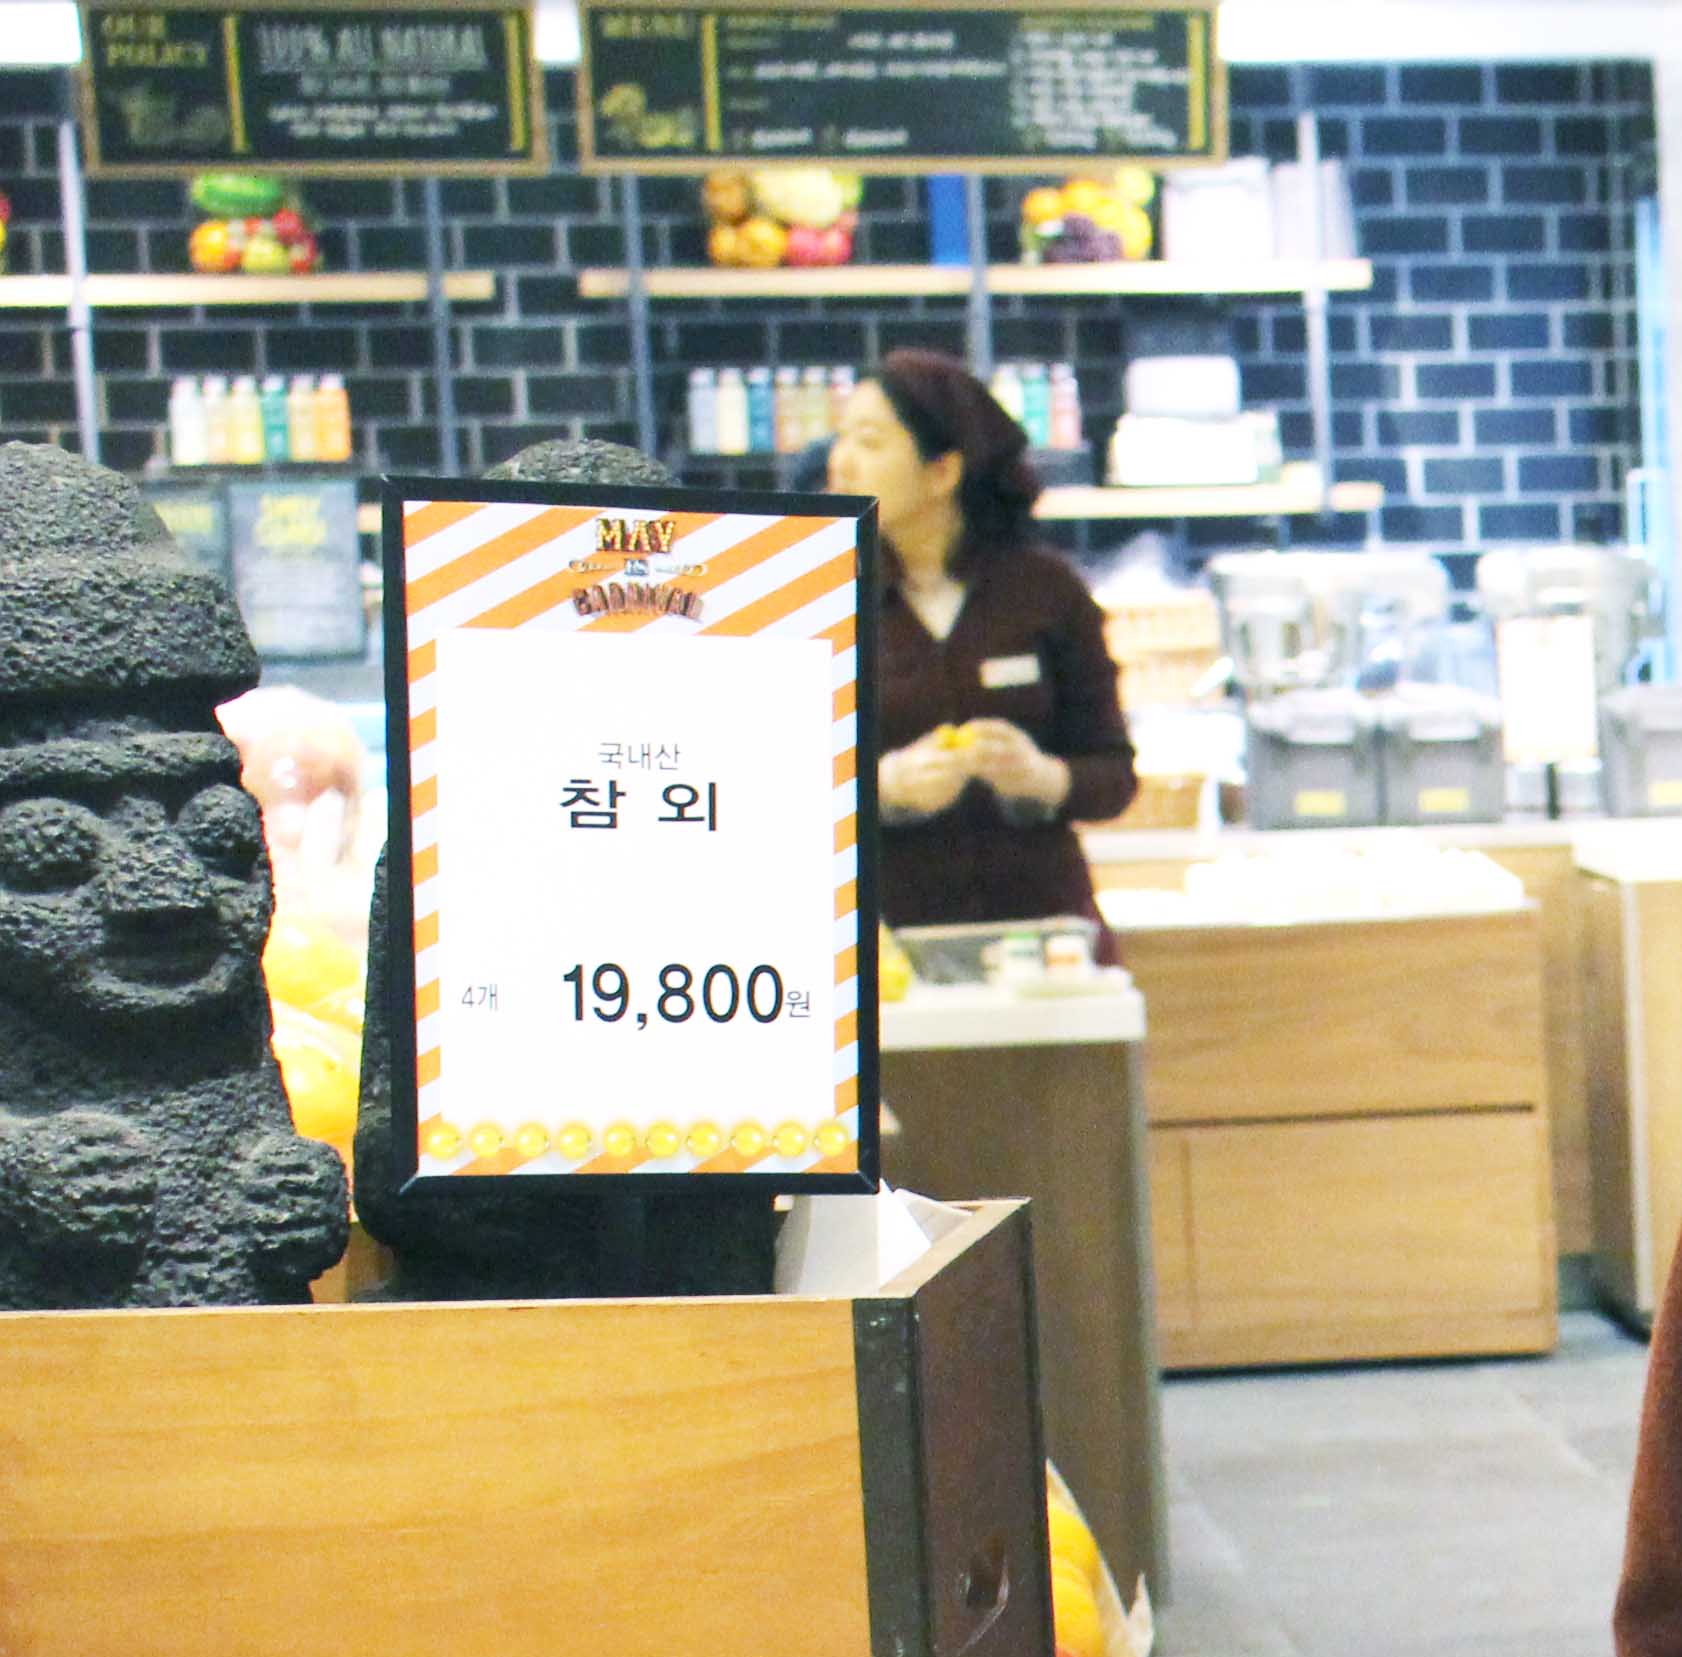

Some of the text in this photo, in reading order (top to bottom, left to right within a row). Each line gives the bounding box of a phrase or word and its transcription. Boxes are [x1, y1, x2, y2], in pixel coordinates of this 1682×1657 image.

[595, 518, 676, 553] MAY
[598, 742, 681, 771] 국내산
[461, 984, 499, 1011] 4개
